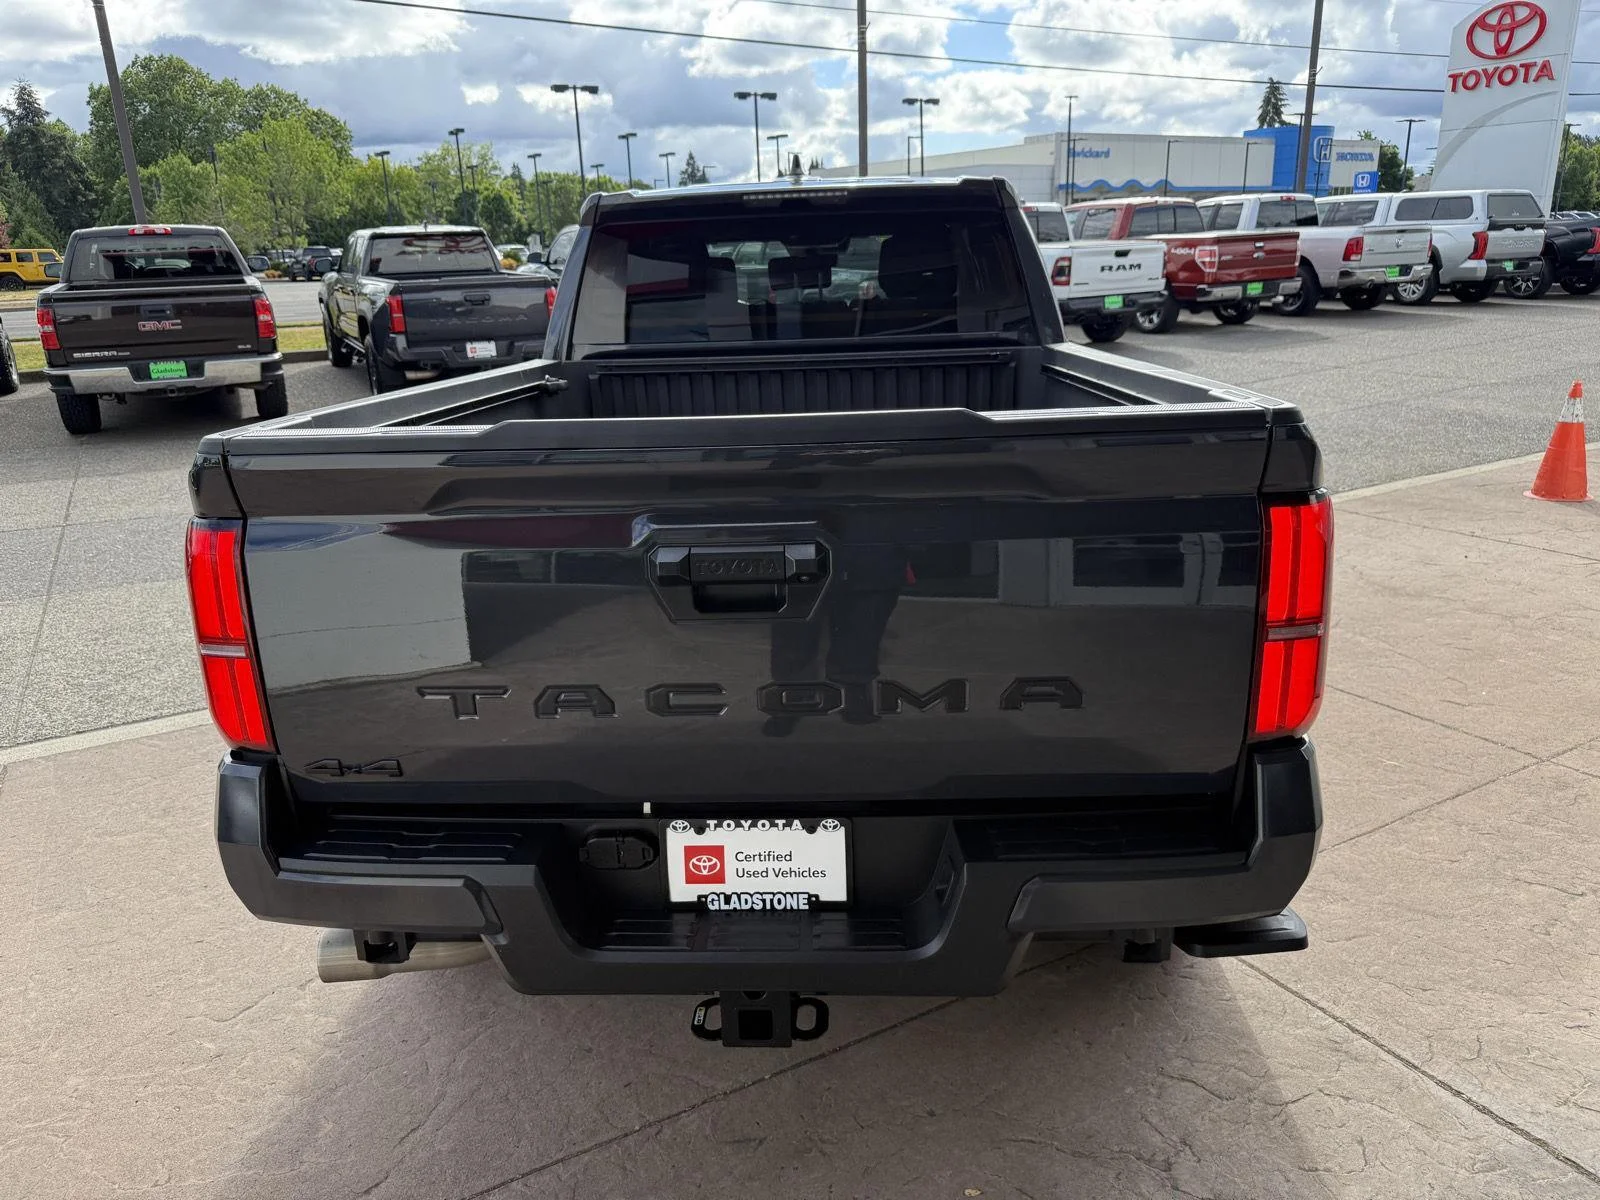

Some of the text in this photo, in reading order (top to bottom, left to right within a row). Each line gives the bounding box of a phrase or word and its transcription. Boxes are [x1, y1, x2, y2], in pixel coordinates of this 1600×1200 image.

[1448, 59, 1555, 93] TOYOTA
[1336, 151, 1375, 161] HONDA
[1100, 263, 1141, 272] RAM
[138, 319, 183, 331] GMC
[73, 350, 117, 358] SIERRA
[151, 366, 186, 375] Gladstone
[695, 558, 782, 576] TOYOTA
[416, 676, 1084, 720] TACOMA
[304, 758, 403, 778] 4x4
[706, 819, 805, 832] TOYOTA
[734, 850, 793, 863] Certified
[736, 867, 827, 879] Used Vehicles
[706, 893, 809, 911] GLADSTONE
